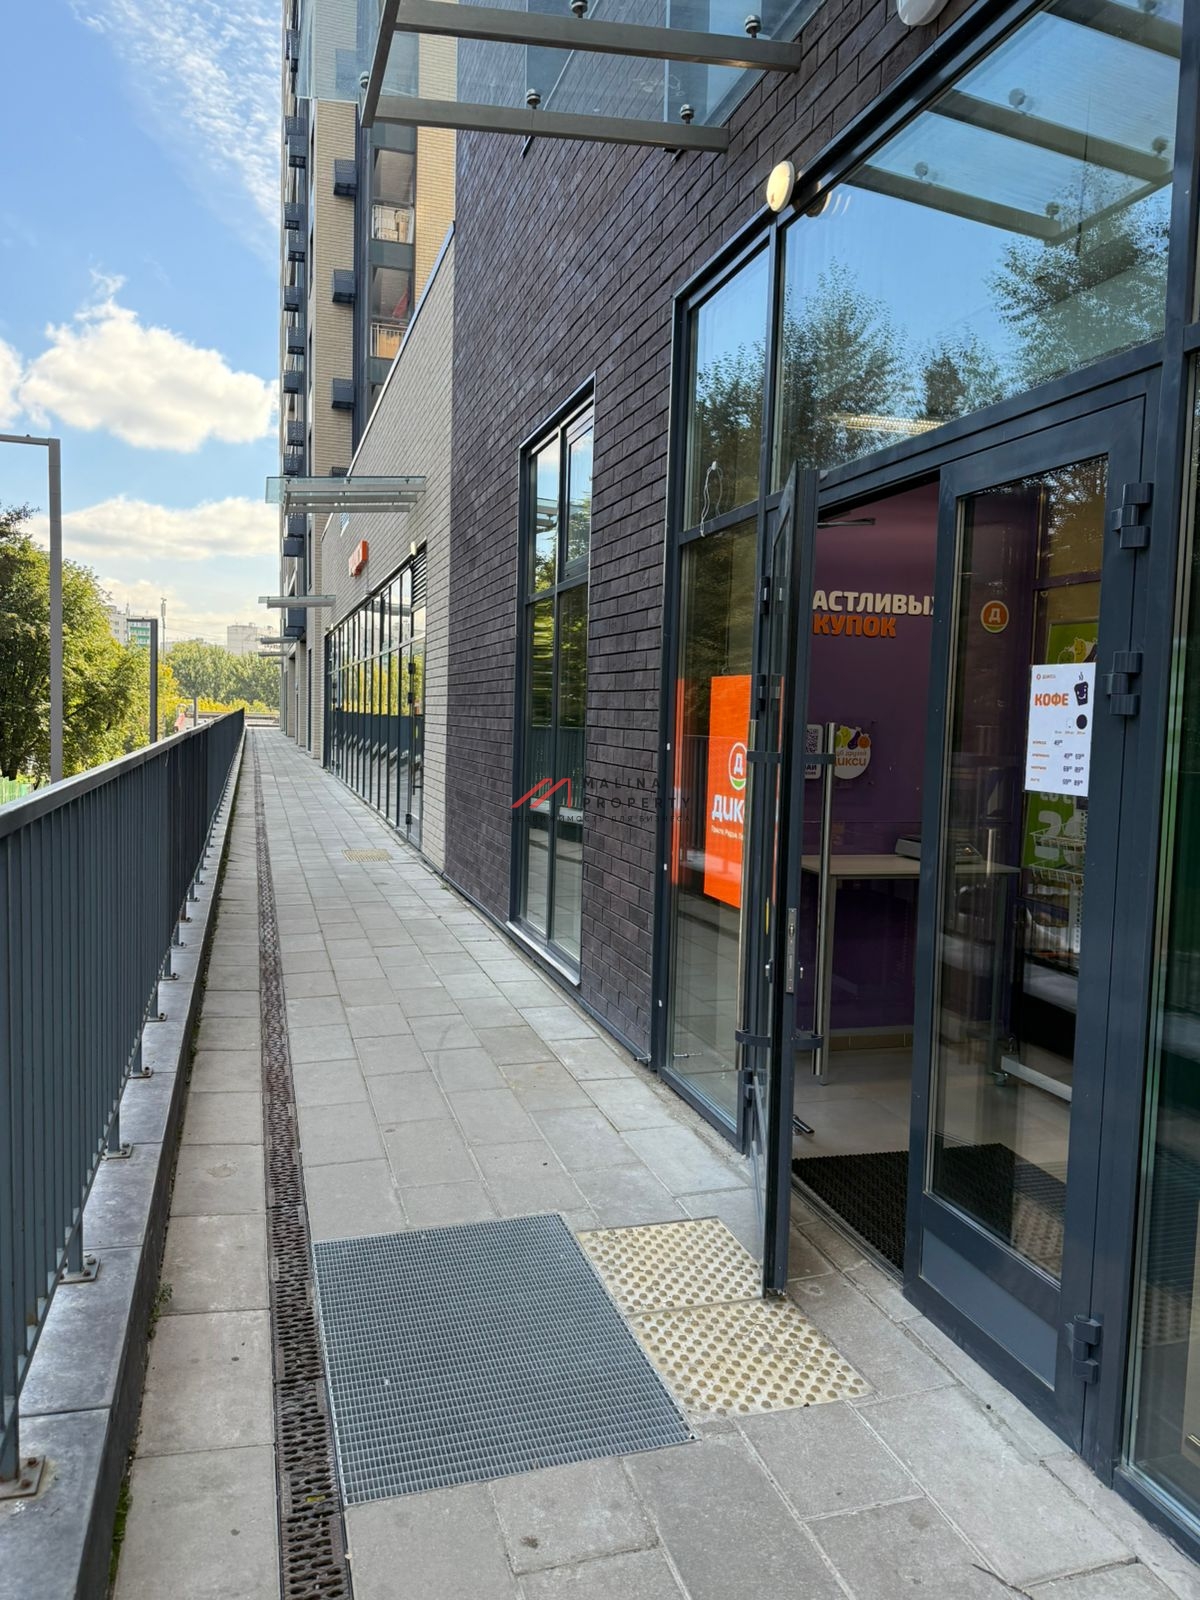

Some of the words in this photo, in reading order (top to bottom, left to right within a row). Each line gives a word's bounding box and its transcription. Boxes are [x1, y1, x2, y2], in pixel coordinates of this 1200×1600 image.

[813, 614, 896, 637] КУПОК
[988, 608, 1001, 623] Д
[1034, 692, 1069, 707] КОФЕ
[733, 753, 744, 776] Д
[711, 793, 746, 824] ДИК
